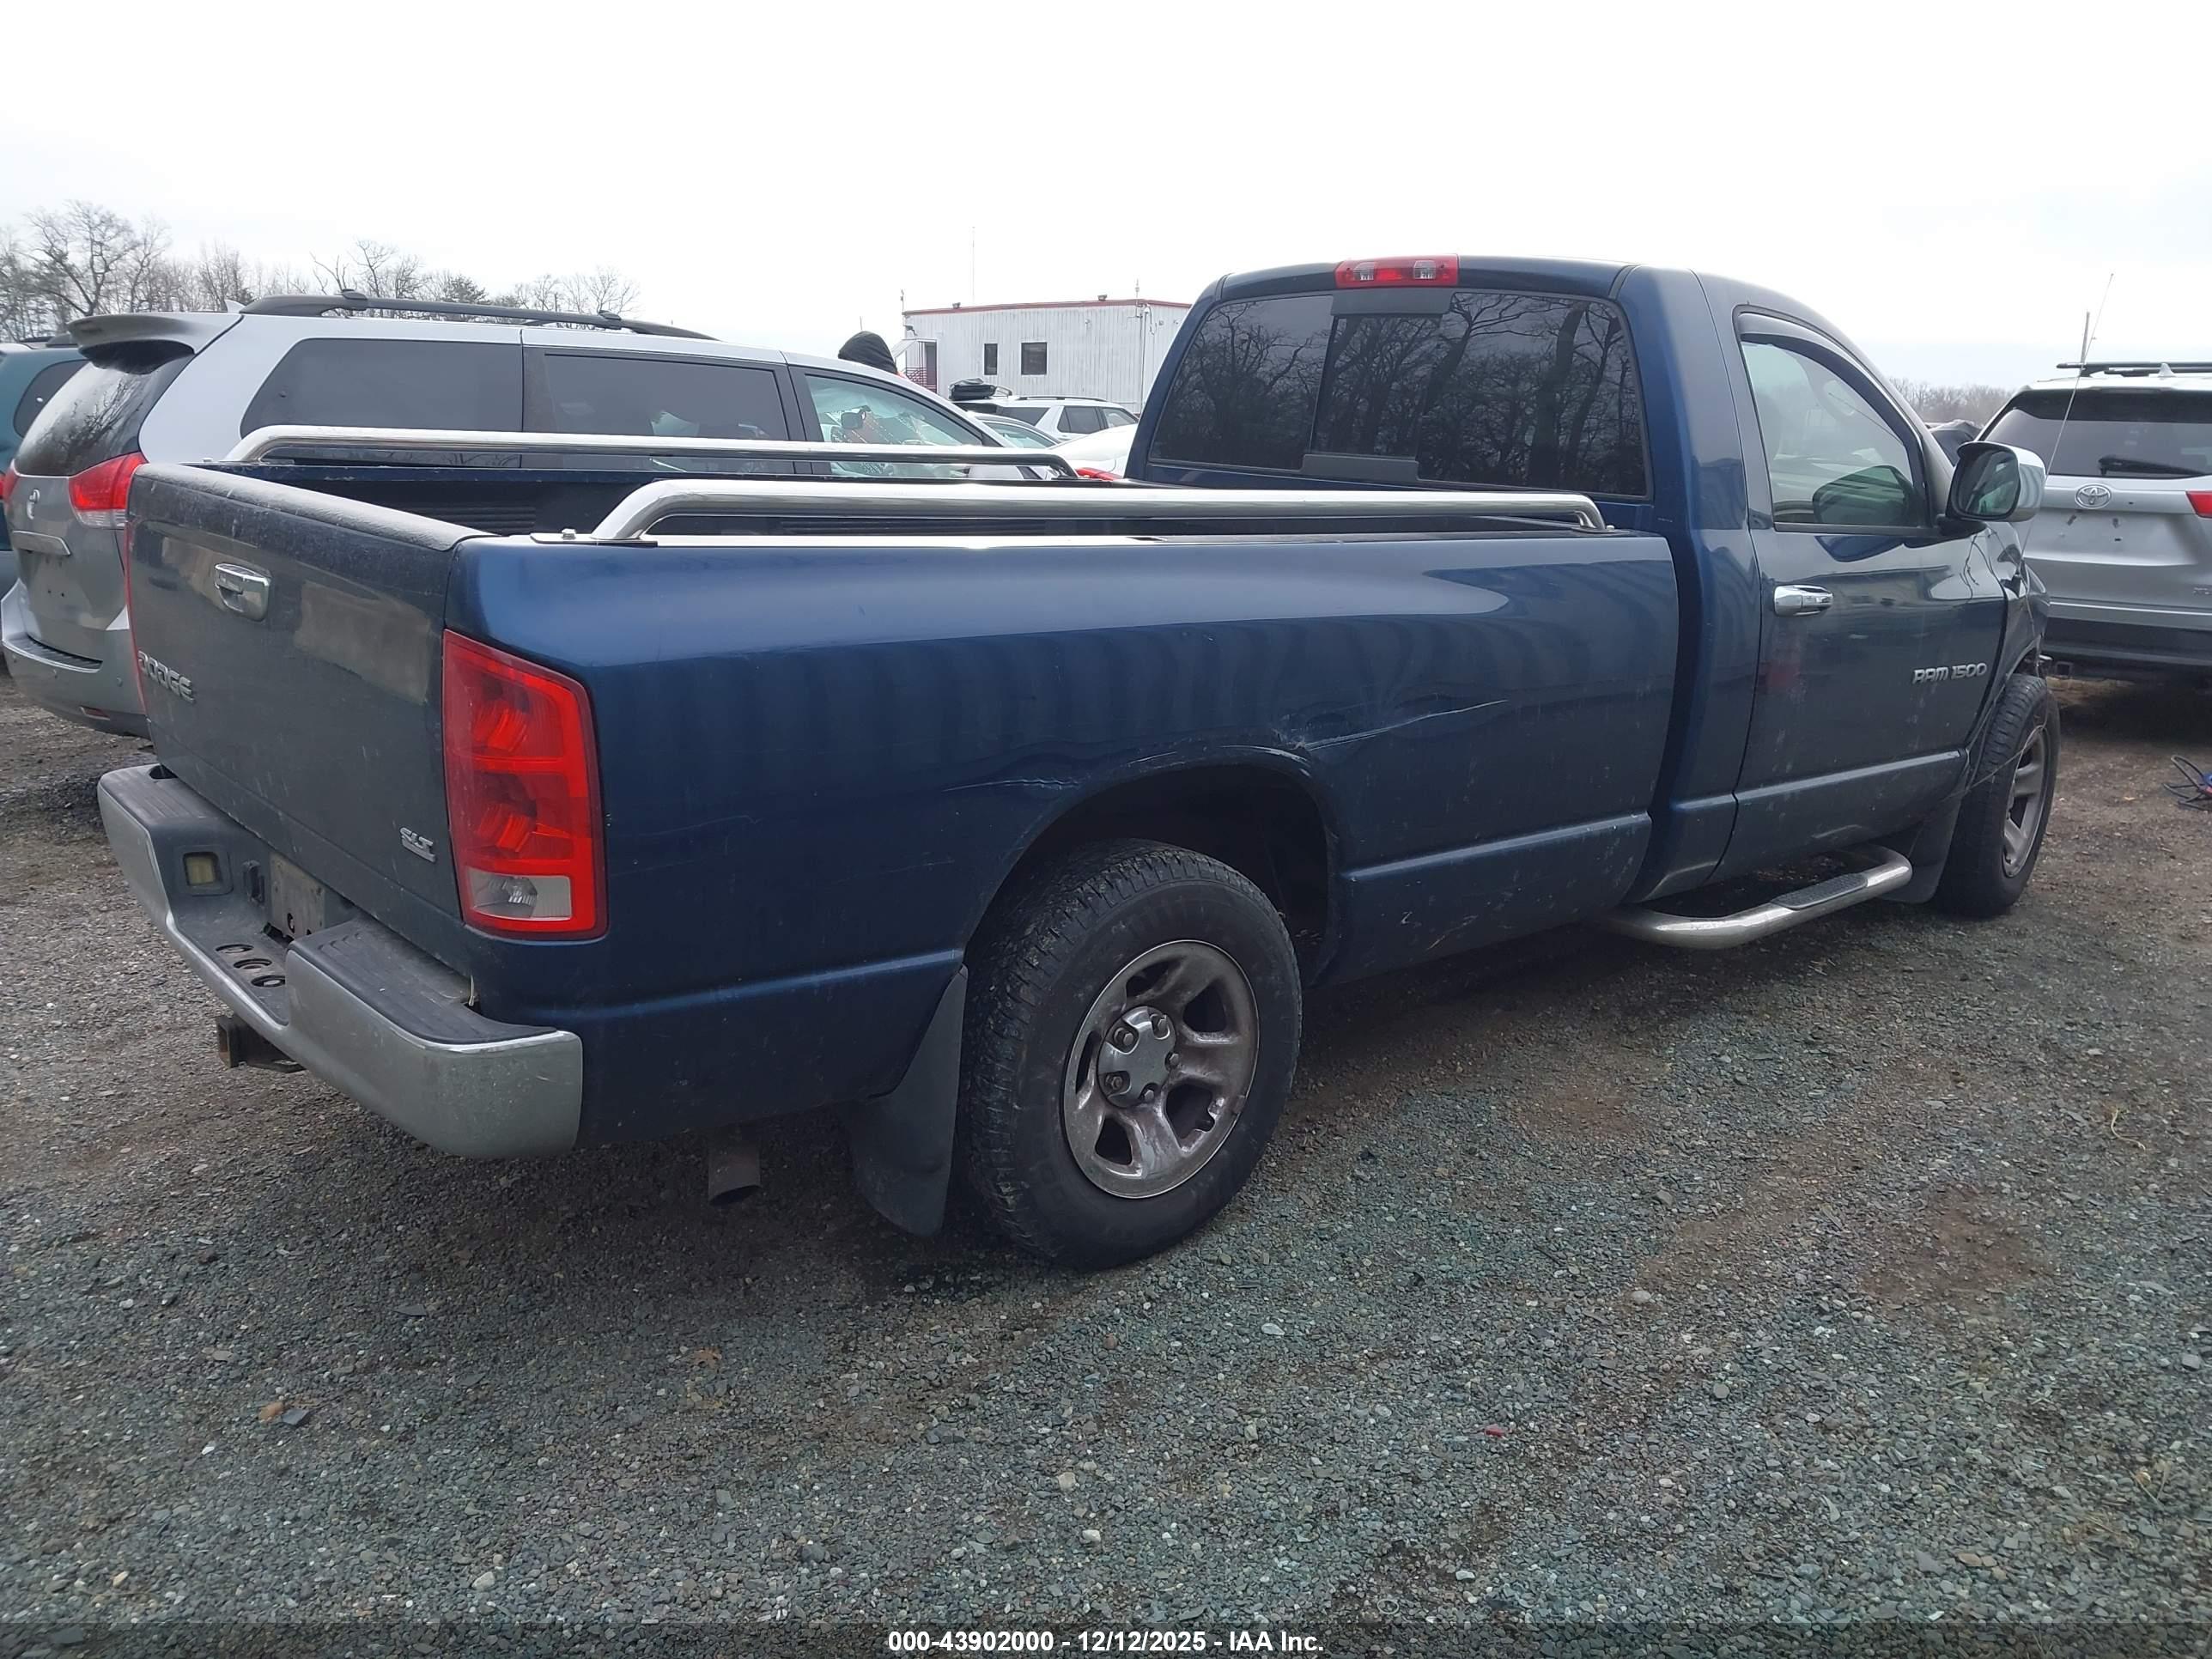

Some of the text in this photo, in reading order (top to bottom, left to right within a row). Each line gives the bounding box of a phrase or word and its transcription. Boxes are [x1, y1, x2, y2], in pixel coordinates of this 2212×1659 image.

[137, 650, 194, 703] DODGE
[1912, 663, 1987, 684] RAM 1500
[400, 827, 434, 857] SLT
